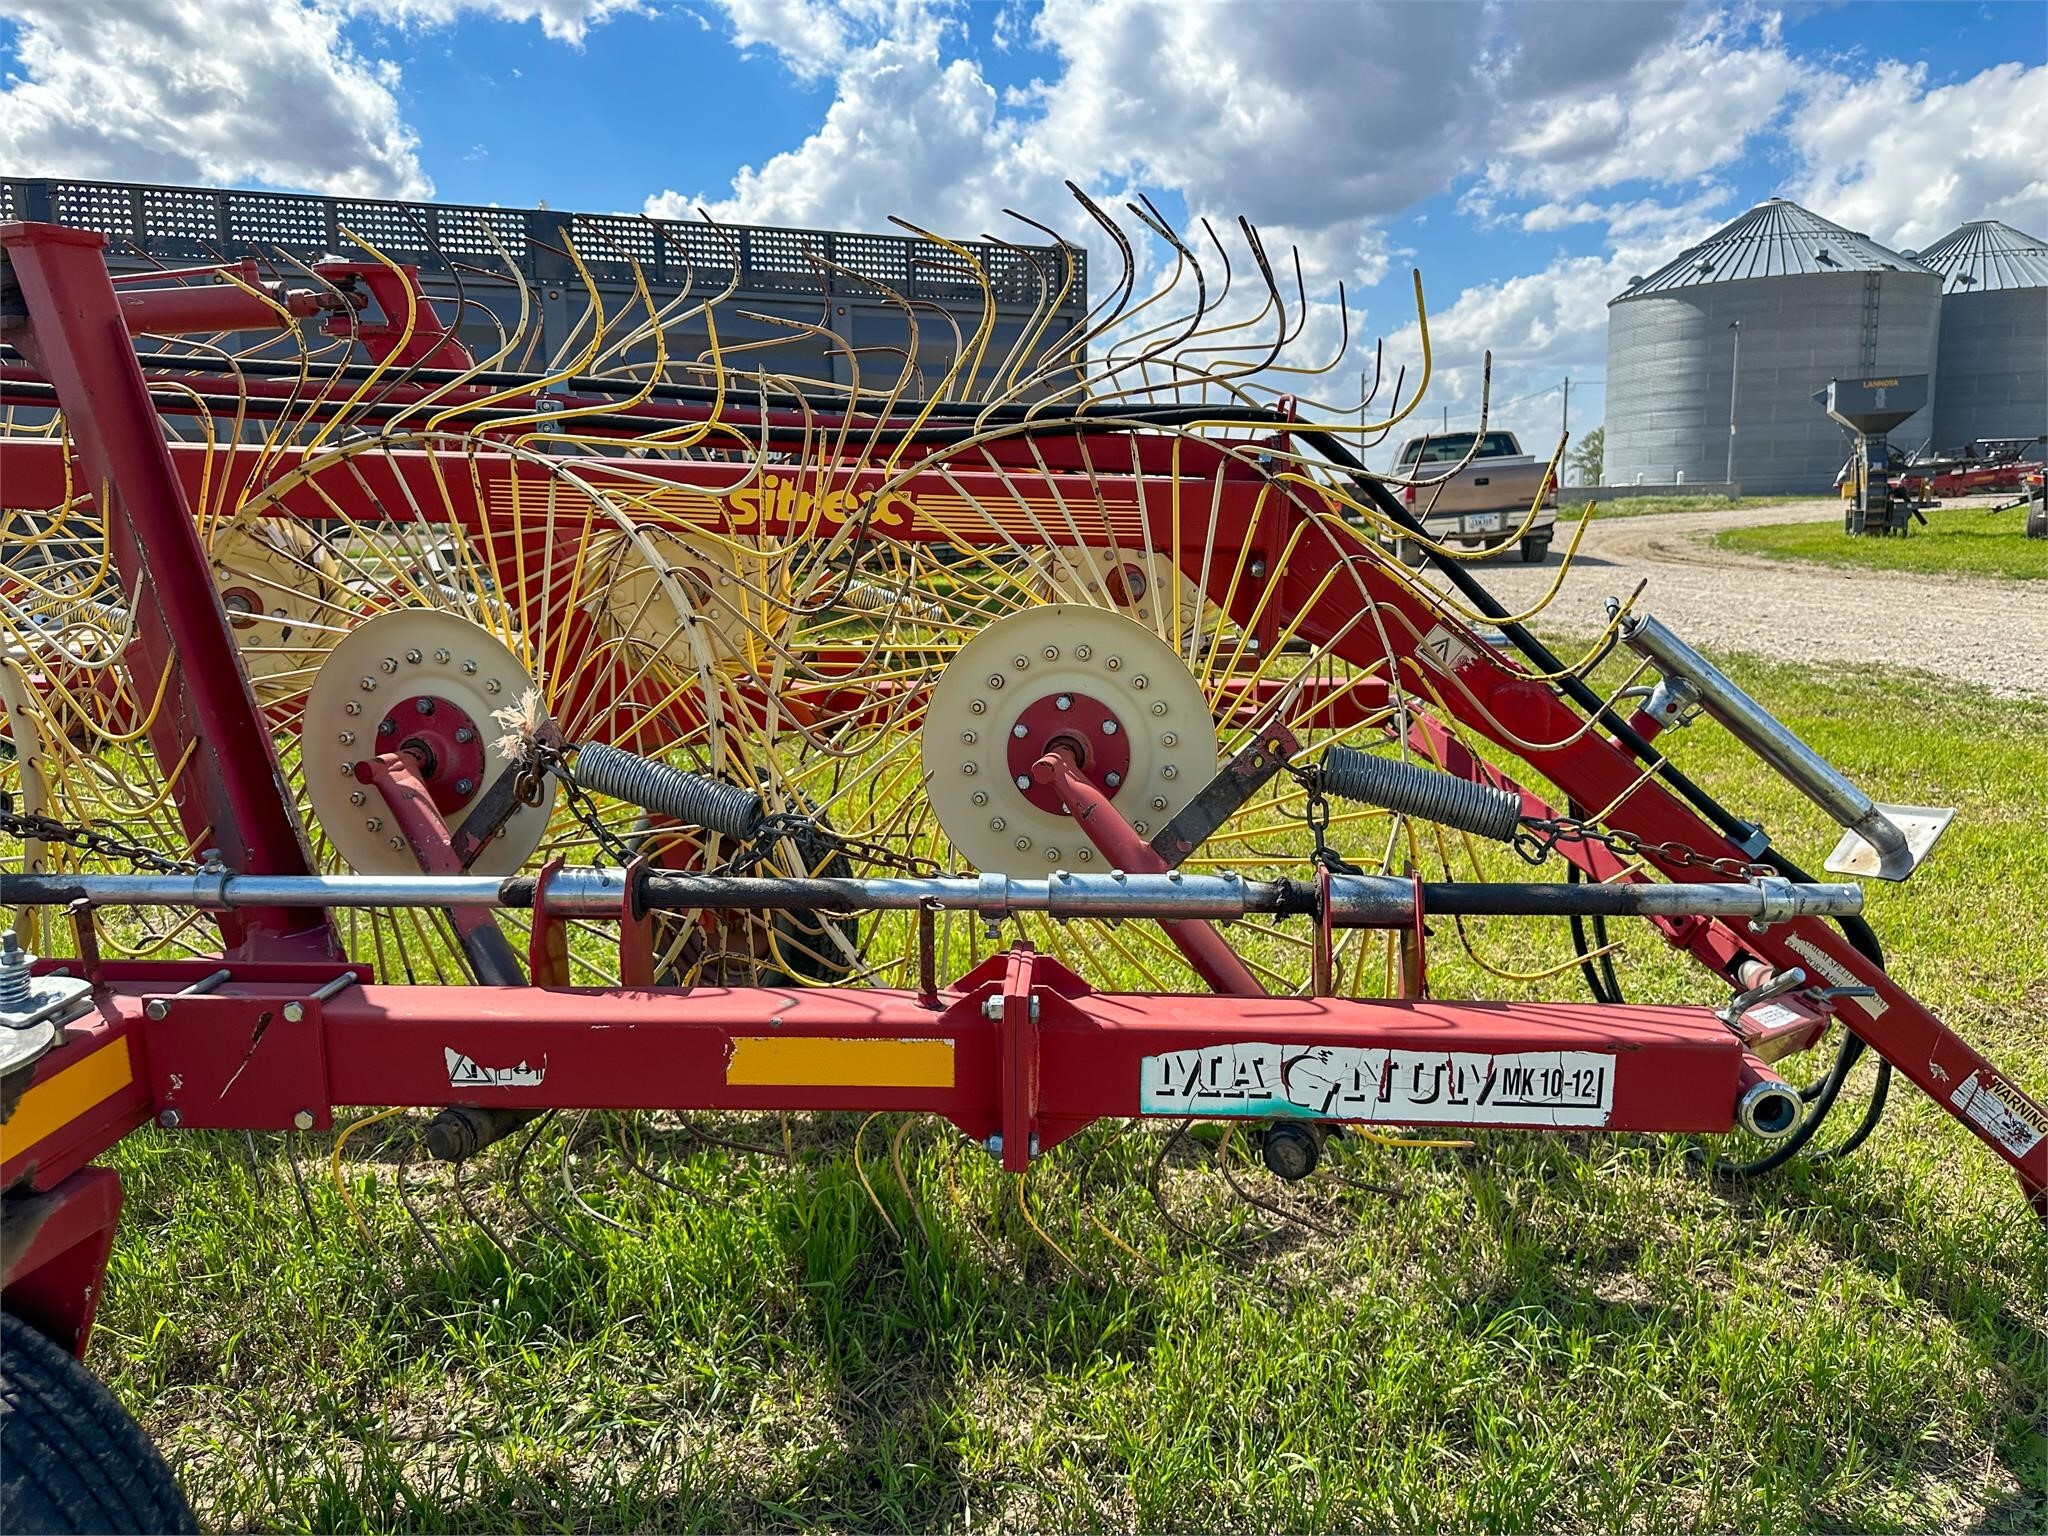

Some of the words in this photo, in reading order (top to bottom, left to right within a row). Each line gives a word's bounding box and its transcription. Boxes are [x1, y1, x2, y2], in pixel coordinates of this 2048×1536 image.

[729, 474, 912, 526] sitrex
[1826, 958, 1854, 981] SPEED
[1502, 1067, 1536, 1096] MK
[1540, 1068, 1595, 1098] 10-12
